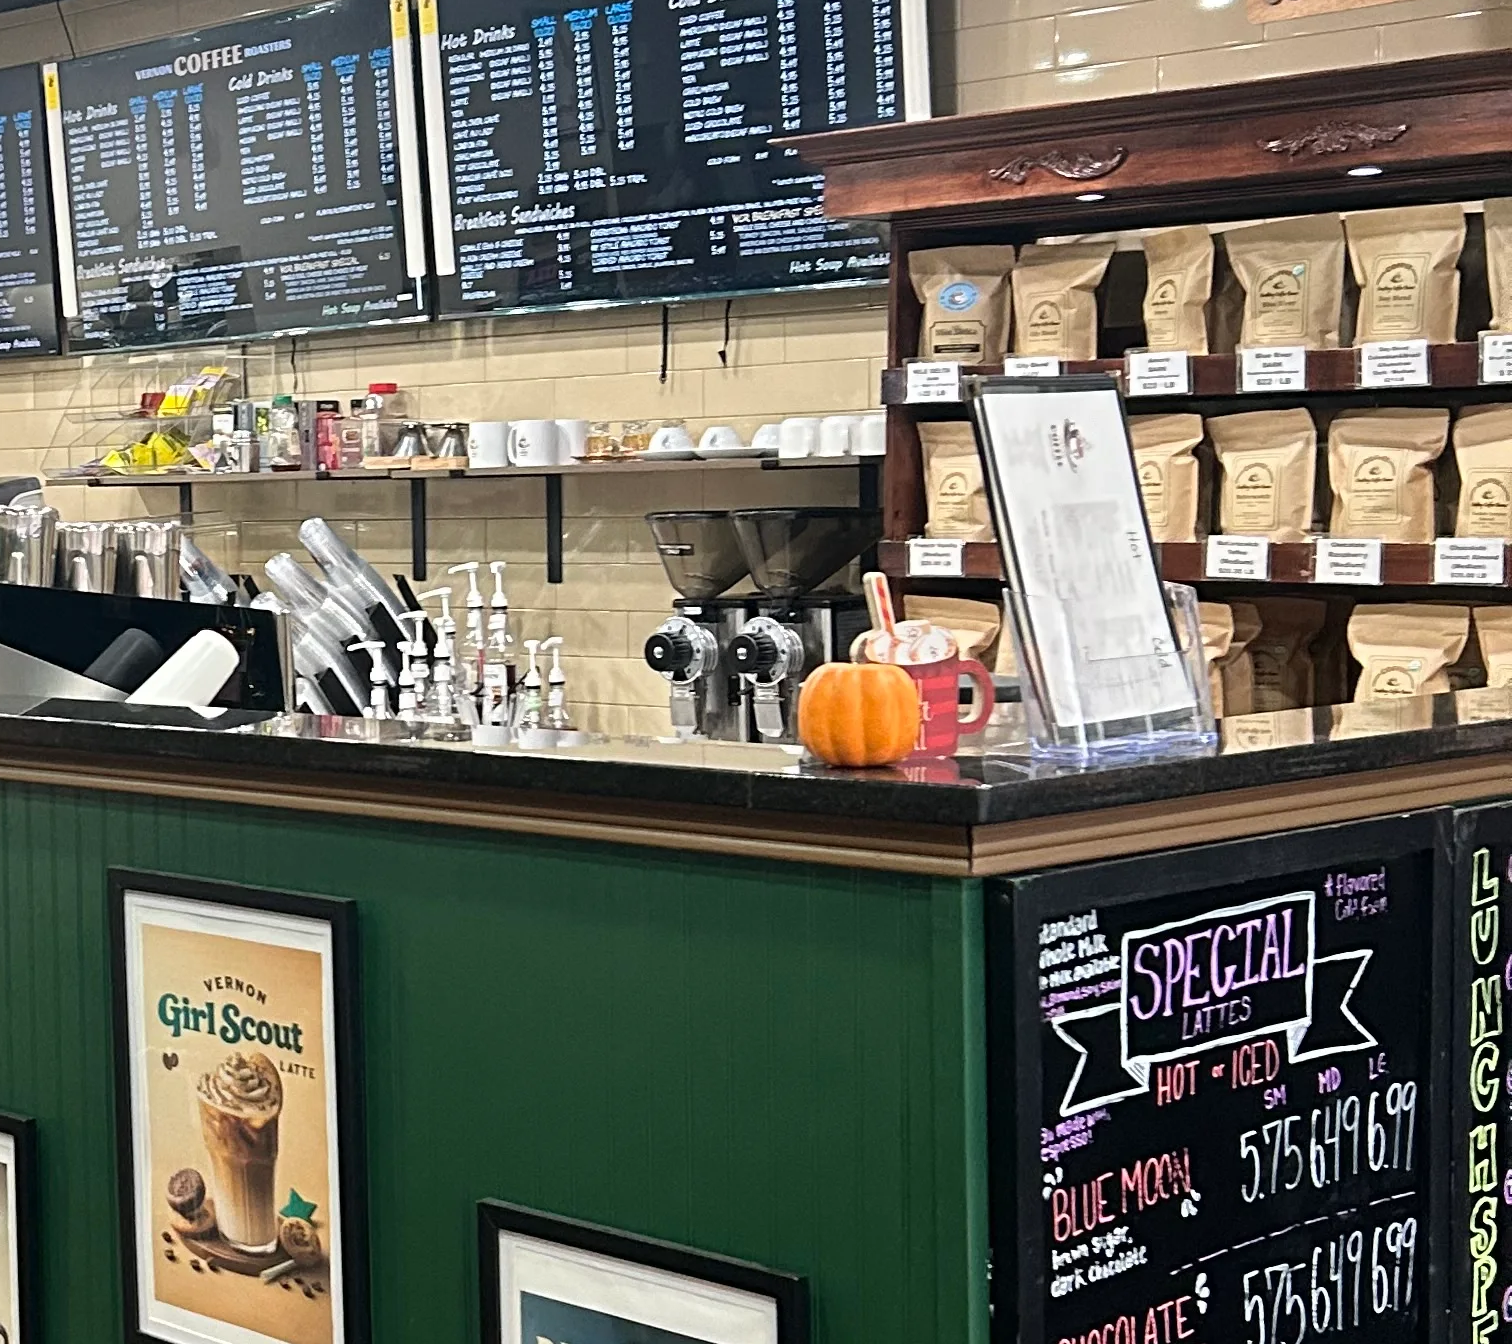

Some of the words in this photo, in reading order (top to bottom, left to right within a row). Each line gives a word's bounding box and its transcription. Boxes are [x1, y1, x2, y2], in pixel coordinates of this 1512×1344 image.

[441, 33, 467, 51] Hot
[472, 24, 516, 46] Drinks
[173, 44, 243, 77] COFFEE
[228, 75, 253, 93] Cold
[257, 67, 294, 88] Drinks
[63, 109, 83, 125] Hot
[86, 103, 118, 121] Drinks
[454, 210, 507, 232] Breakfast
[510, 202, 576, 225] Sandwiches
[789, 261, 811, 274] Hot
[816, 258, 843, 272] Soup
[847, 253, 890, 268] Availabl
[1129, 909, 1306, 1021] SPECIAL
[203, 975, 268, 1005] VERNON
[157, 992, 216, 1037] Girl
[219, 1001, 304, 1056] Scout
[1181, 995, 1252, 1040] LATTES
[1469, 846, 1504, 1194] LUNCH
[279, 1059, 317, 1080] LATTE
[1156, 1062, 1196, 1106] HOT
[1232, 1039, 1280, 1089] ICED
[1263, 1084, 1287, 1110] SM
[1052, 1172, 1116, 1242] BLUE
[1120, 1146, 1192, 1214] MOON
[1240, 1116, 1303, 1204] 5.75
[1310, 1094, 1360, 1189] 6.49
[1367, 1081, 1418, 1173] 6.99
[1311, 1229, 1361, 1334] 6.49
[1372, 1217, 1417, 1314] 6.99
